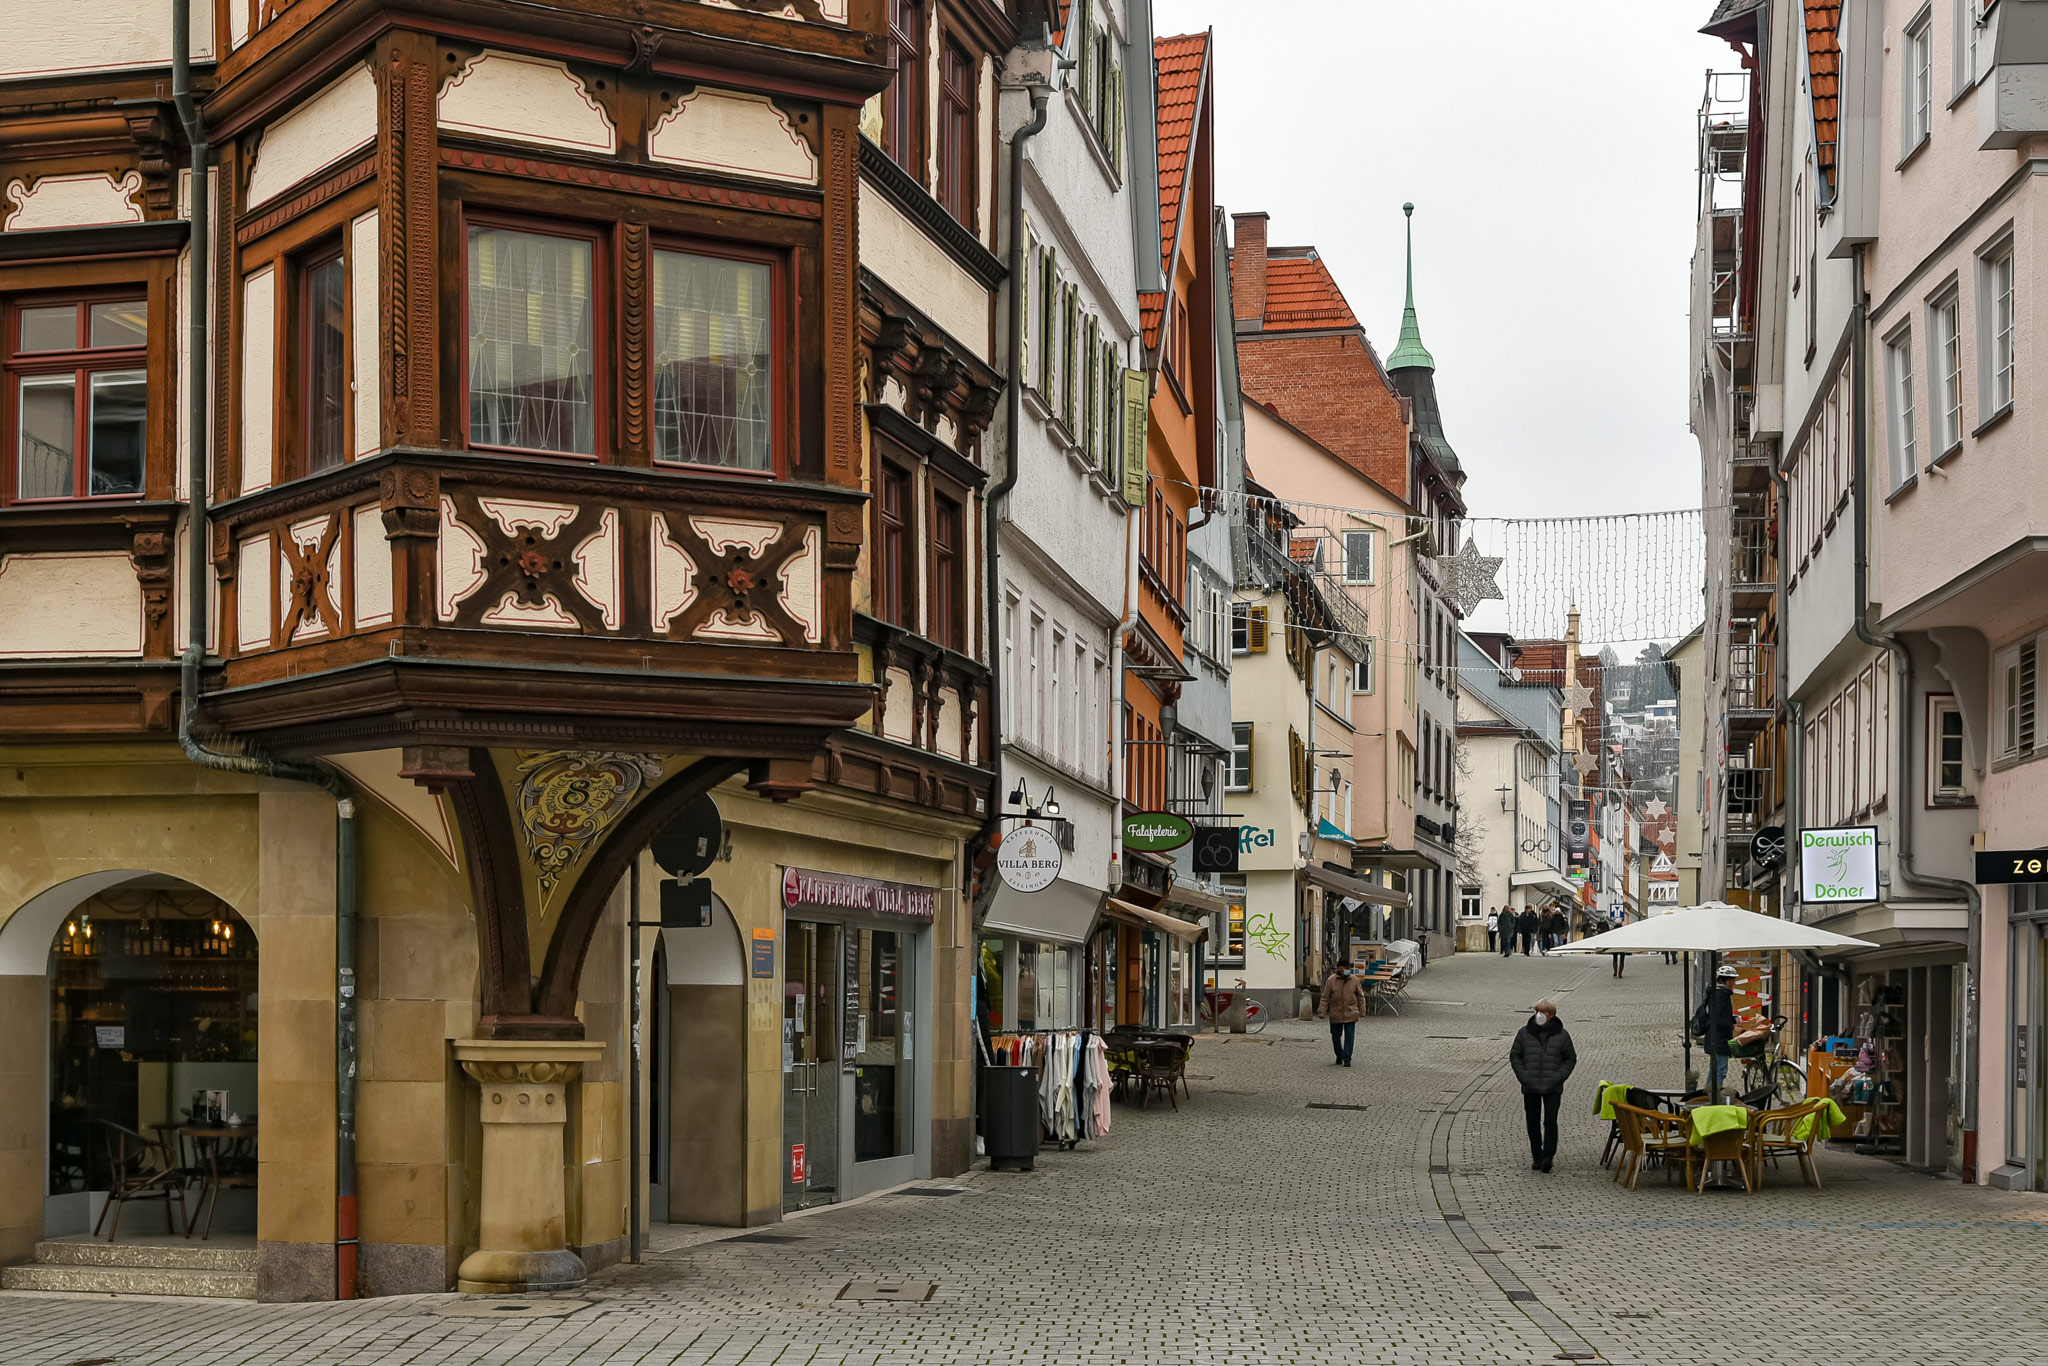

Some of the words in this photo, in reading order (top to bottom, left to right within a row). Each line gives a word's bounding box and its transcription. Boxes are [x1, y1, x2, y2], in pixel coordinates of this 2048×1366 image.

[1006, 830, 1053, 844] KAFFEEHAUS
[1127, 823, 1179, 843] Falafelerie
[1804, 831, 1873, 848] Derwisch
[999, 860, 1029, 869] VILLA
[1031, 860, 1059, 869] BERG
[1008, 878, 1048, 889] ESSLINGEN
[1815, 883, 1865, 899] Döner
[874, 886, 905, 914] VILLA
[907, 890, 935, 917] BERG
